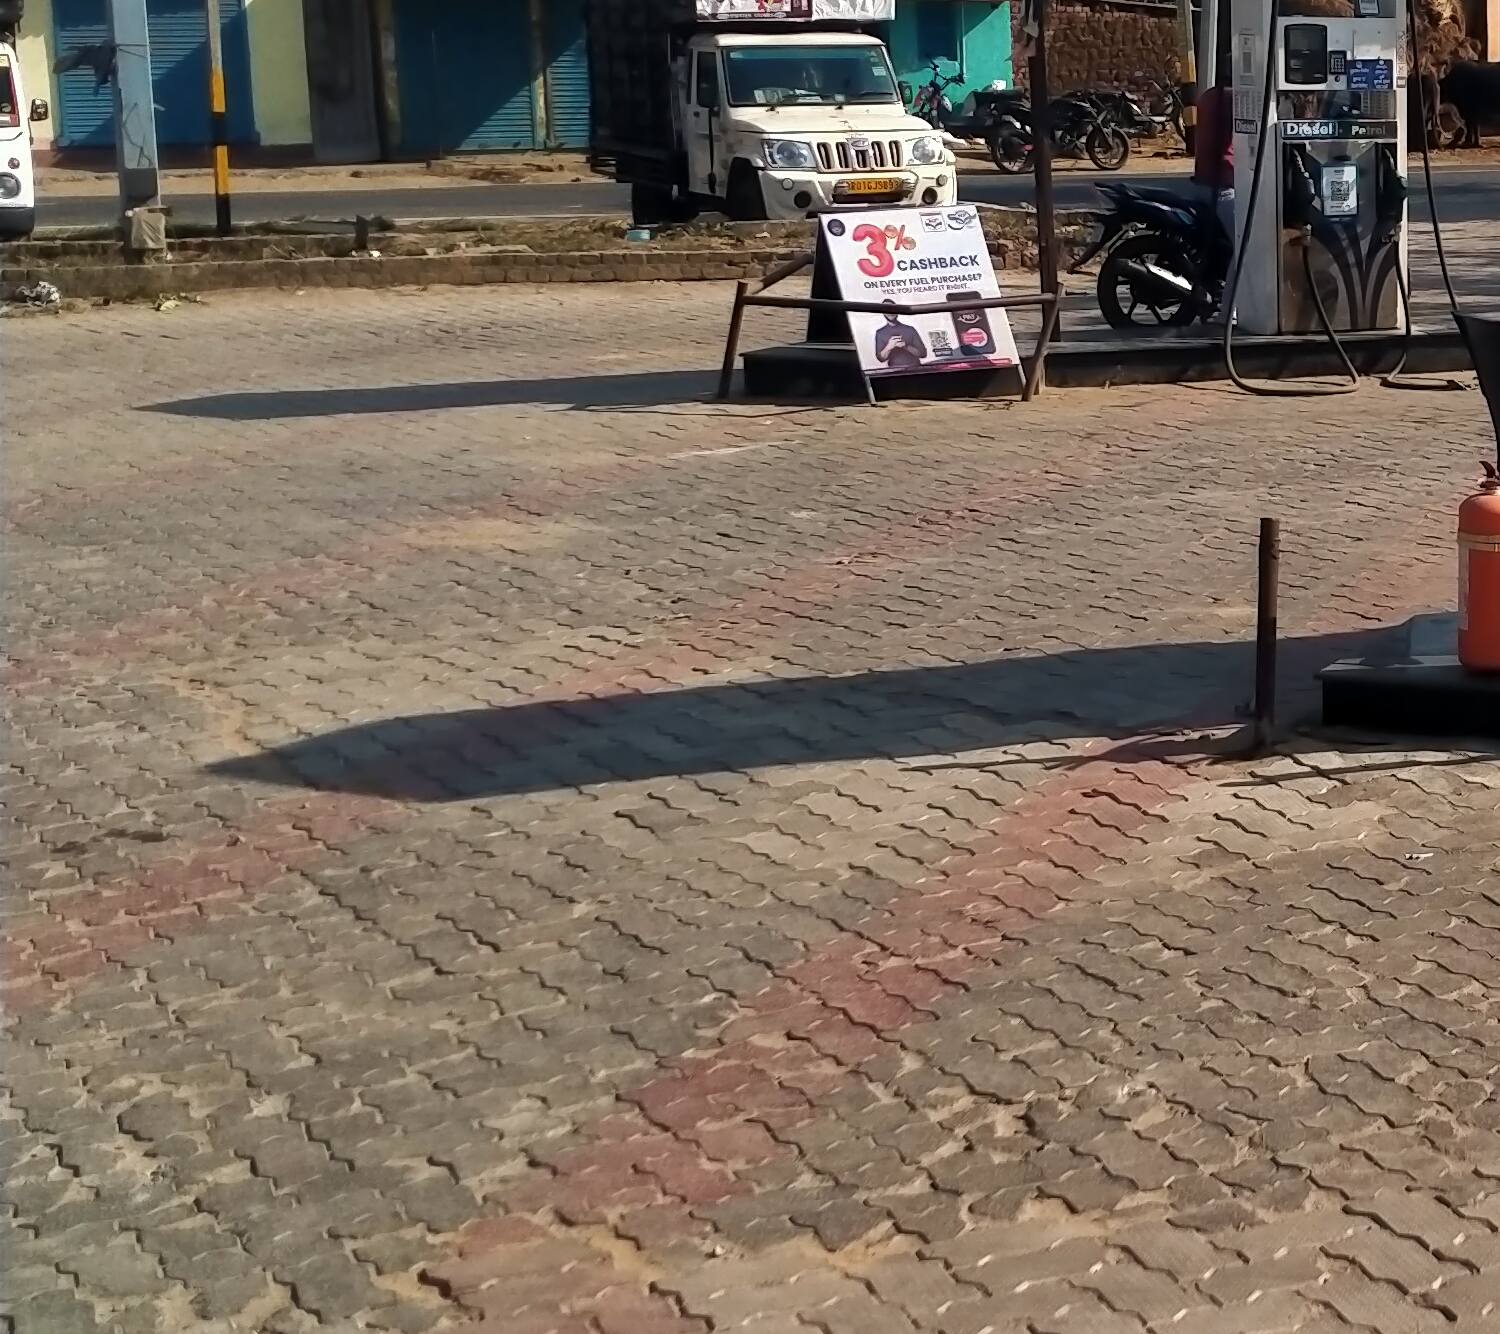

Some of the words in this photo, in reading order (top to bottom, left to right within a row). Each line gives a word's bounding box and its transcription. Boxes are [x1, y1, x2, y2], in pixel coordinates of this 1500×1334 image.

[1351, 125, 1386, 136] Petrol
[897, 254, 980, 272] CASHBACK
[864, 281, 879, 289] ON
[879, 278, 908, 288] EVERY
[909, 276, 931, 286] FUEL
[931, 272, 982, 285] PURCHASE?
